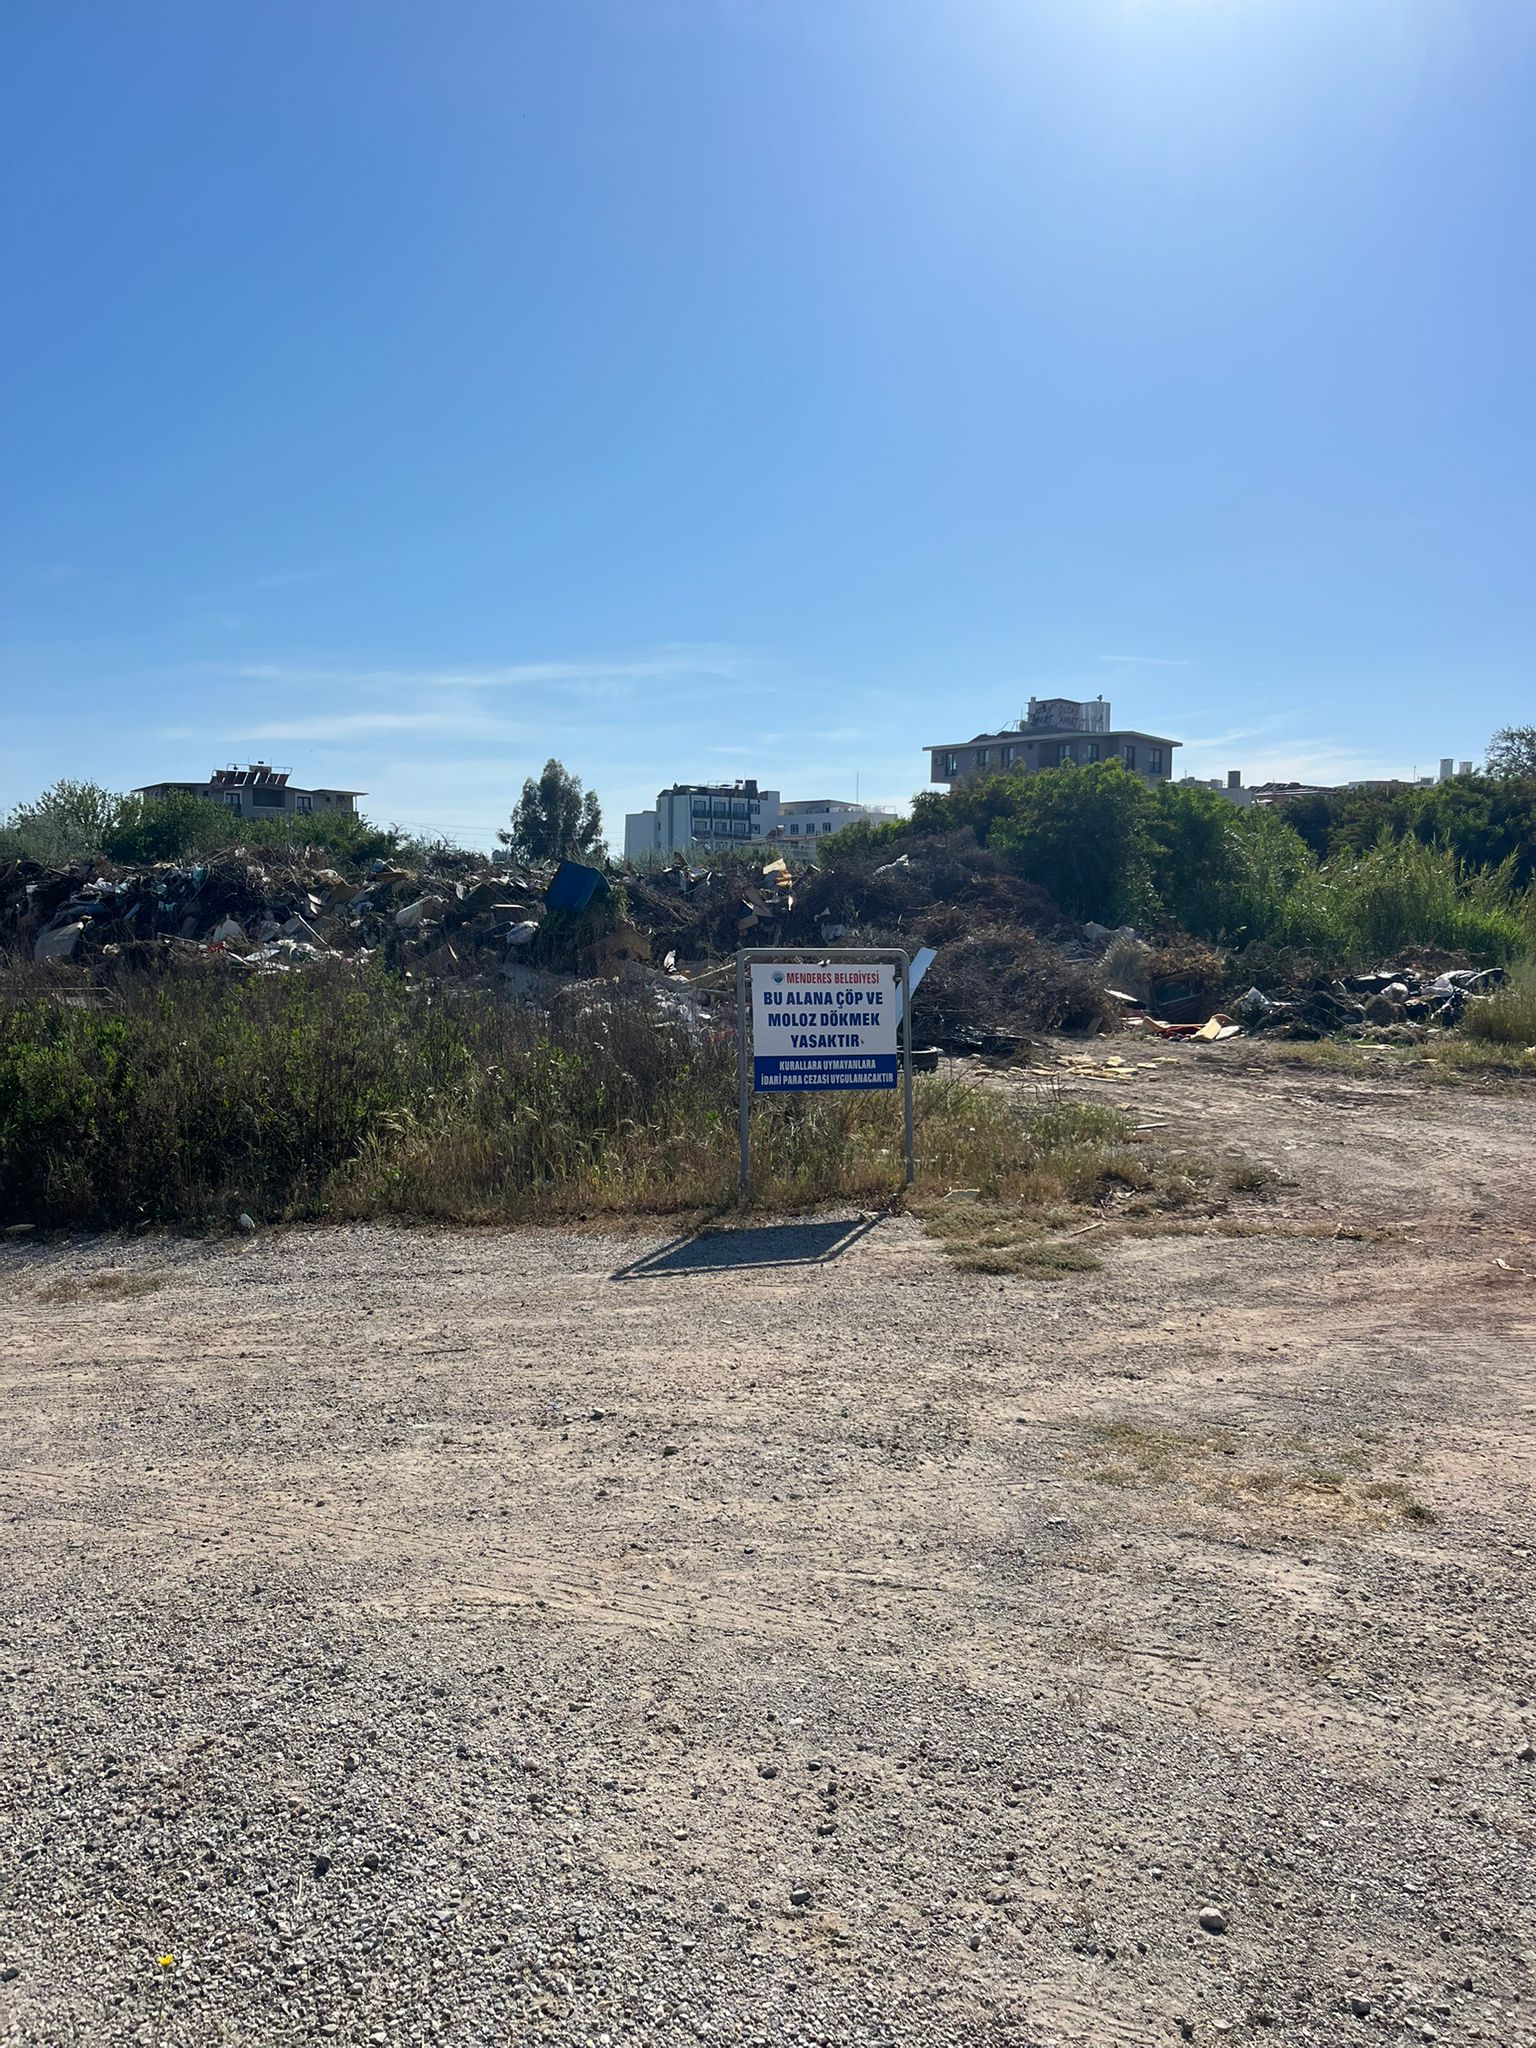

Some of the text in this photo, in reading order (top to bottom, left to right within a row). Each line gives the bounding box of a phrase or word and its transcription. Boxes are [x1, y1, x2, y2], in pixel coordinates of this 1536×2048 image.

[787, 970, 880, 984] MENDERES BELEDİYESİ
[763, 989, 883, 1009] BU ALANA ÇÖP VE
[768, 1010, 880, 1027] MOLOZ DÖKMEK
[779, 1059, 876, 1071] KURALLARA UYMAYANLARA
[761, 1073, 894, 1086] İDARİ PARA CEZASI UYGULANACAKTIR
